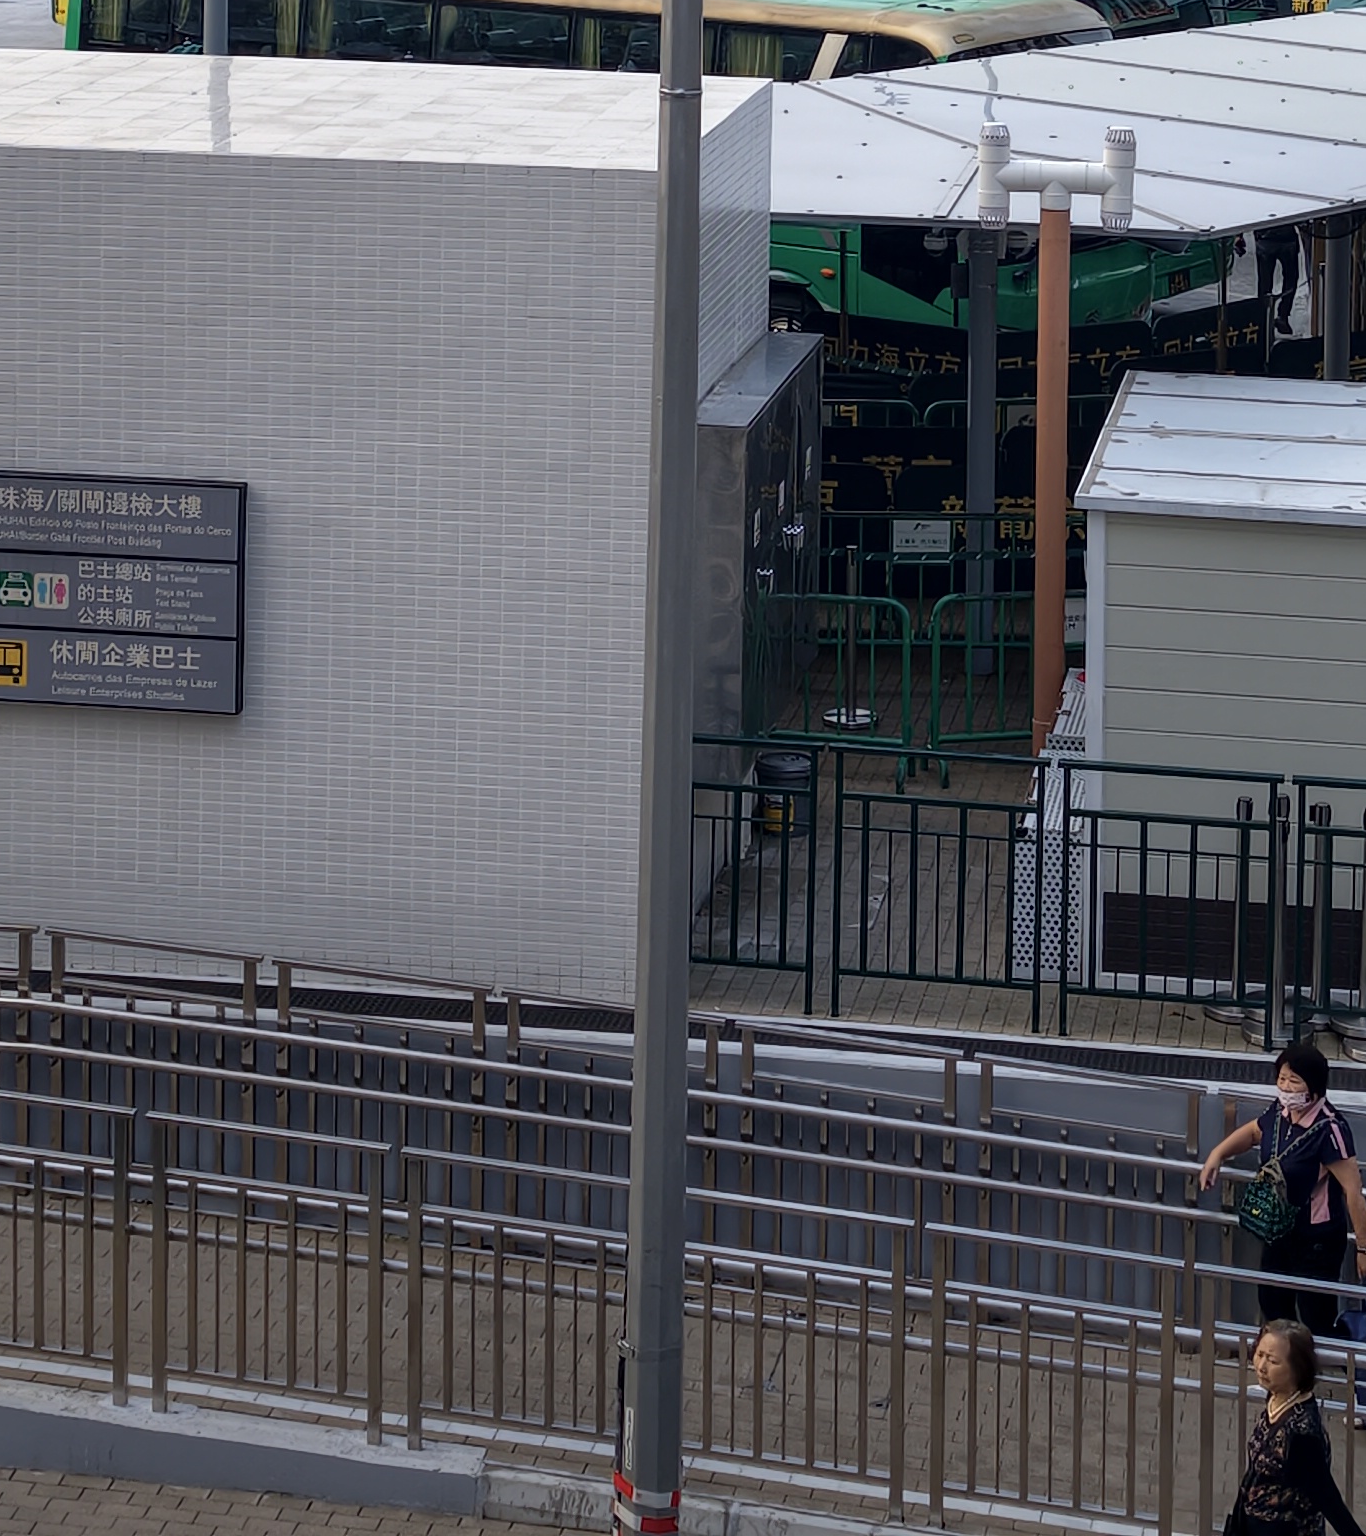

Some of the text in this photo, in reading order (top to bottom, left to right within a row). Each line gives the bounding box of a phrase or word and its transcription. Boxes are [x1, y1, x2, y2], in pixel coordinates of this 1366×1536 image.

[107, 534, 126, 546] Post
[128, 536, 162, 549] Building
[78, 560, 152, 582] 巴士總站
[77, 583, 133, 604] 的士站
[77, 606, 152, 628] 公共廁所
[51, 670, 103, 683] Autocarros
[105, 673, 123, 684] das
[126, 674, 173, 687] Empresas
[191, 678, 218, 689] Lazer
[51, 685, 185, 701] Leisure Enterprises Shuttles
